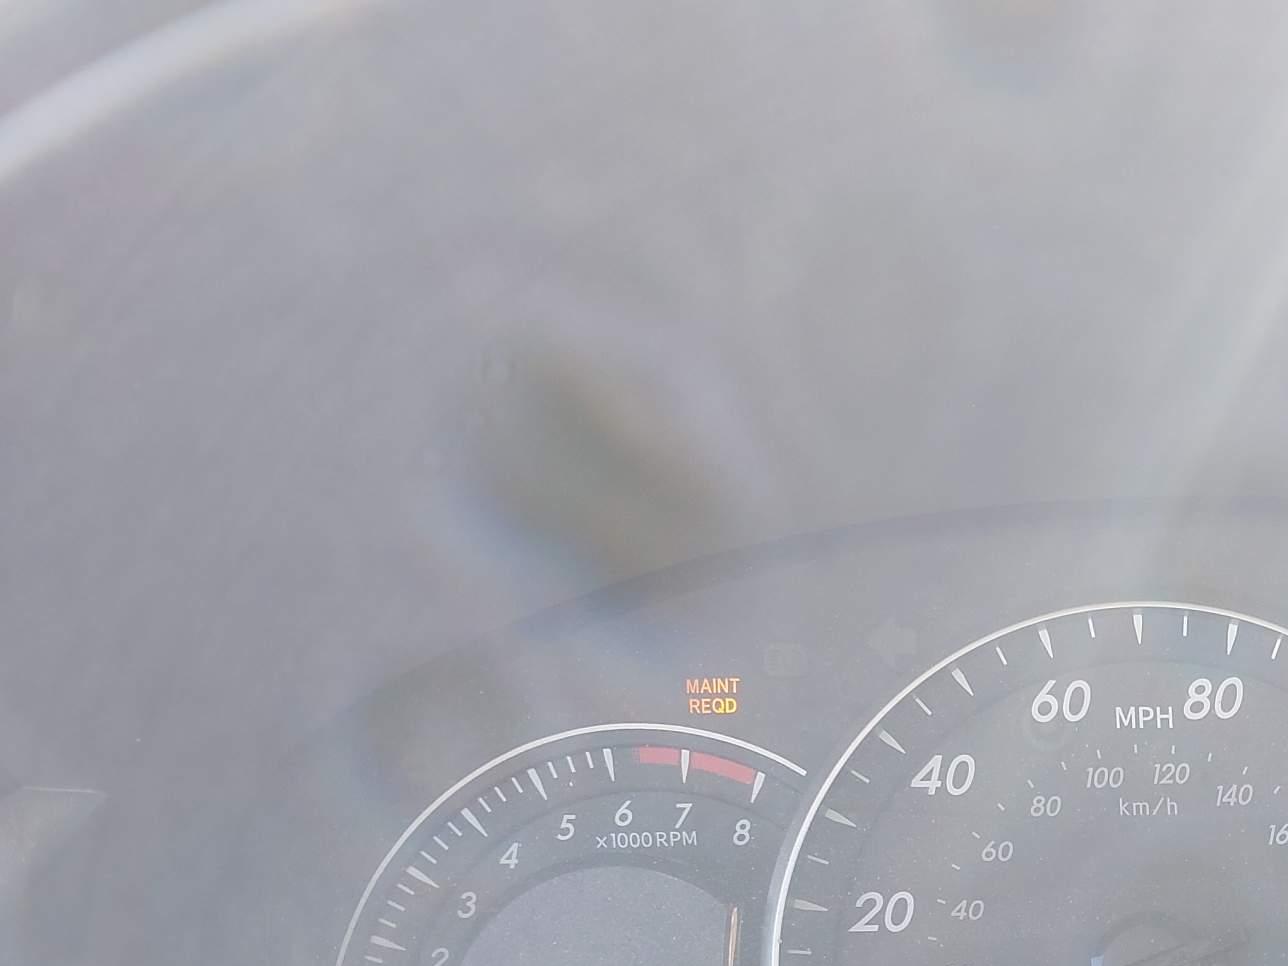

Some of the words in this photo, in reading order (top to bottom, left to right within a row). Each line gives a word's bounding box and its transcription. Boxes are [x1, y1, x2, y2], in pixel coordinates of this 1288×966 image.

[685, 677, 742, 694] MAINT
[690, 697, 738, 714] REQD
[1030, 679, 1092, 724] 60
[1183, 676, 1245, 721] 80
[1114, 705, 1174, 729] MPH
[910, 753, 976, 797] 40
[1085, 767, 1125, 789] 100
[1153, 763, 1191, 785] 120
[1029, 795, 1062, 818] 80
[1119, 797, 1180, 817] km/h
[1215, 784, 1254, 807] 140
[614, 800, 634, 826] 6
[675, 803, 693, 829] 7
[558, 814, 577, 842] 5
[732, 818, 752, 846] 8
[500, 842, 520, 869] 4
[981, 840, 1014, 862] 60
[457, 891, 478, 918] 3
[848, 891, 915, 934] 20
[950, 899, 985, 921] 40
